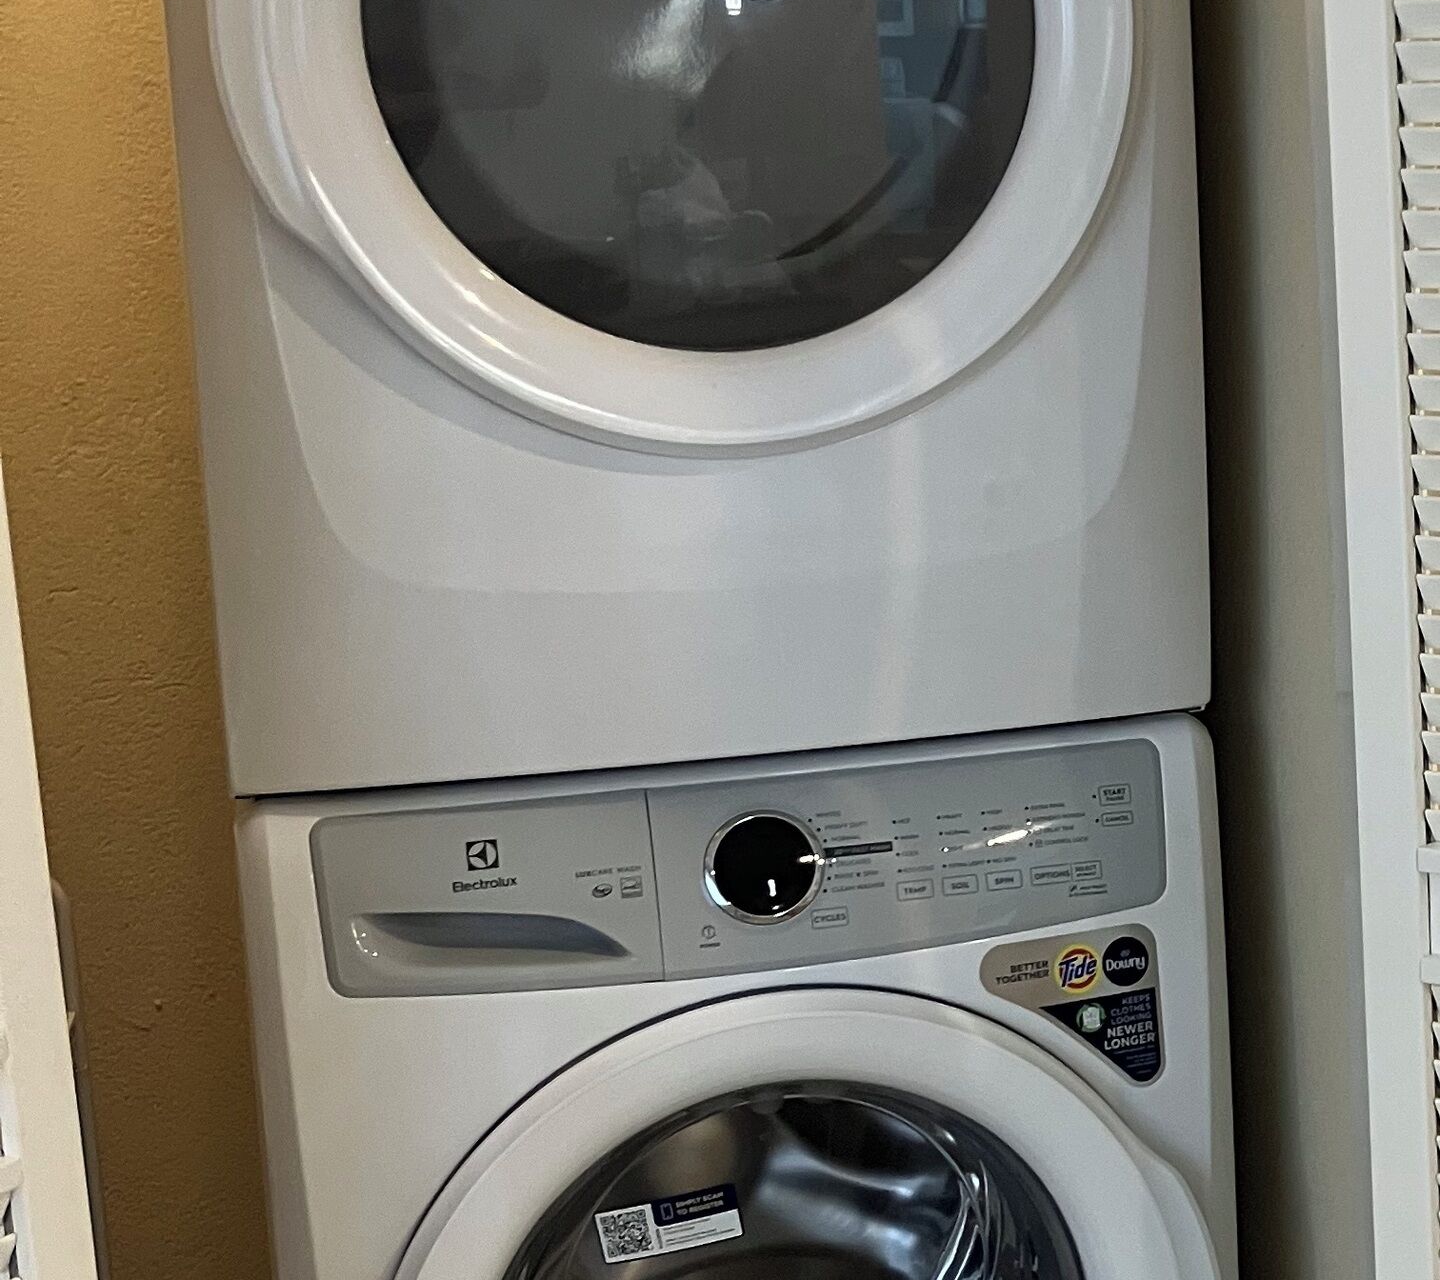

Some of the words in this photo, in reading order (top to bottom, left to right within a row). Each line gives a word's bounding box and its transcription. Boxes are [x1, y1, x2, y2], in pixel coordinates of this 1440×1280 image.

[452, 877, 517, 893] Electrolux
[903, 885, 927, 895] TEMP
[814, 913, 847, 924] CYCLES
[1010, 959, 1049, 974] BETTER
[1058, 954, 1098, 988] Tide
[1105, 956, 1146, 972] Downy
[995, 970, 1050, 985] TOGETHER
[1121, 993, 1151, 1006] KEEPS
[1110, 1001, 1152, 1017] CLOTHES
[1110, 1011, 1153, 1026] LOOKING
[1106, 1020, 1153, 1039] NEWER
[1103, 1032, 1156, 1051] LONGER
